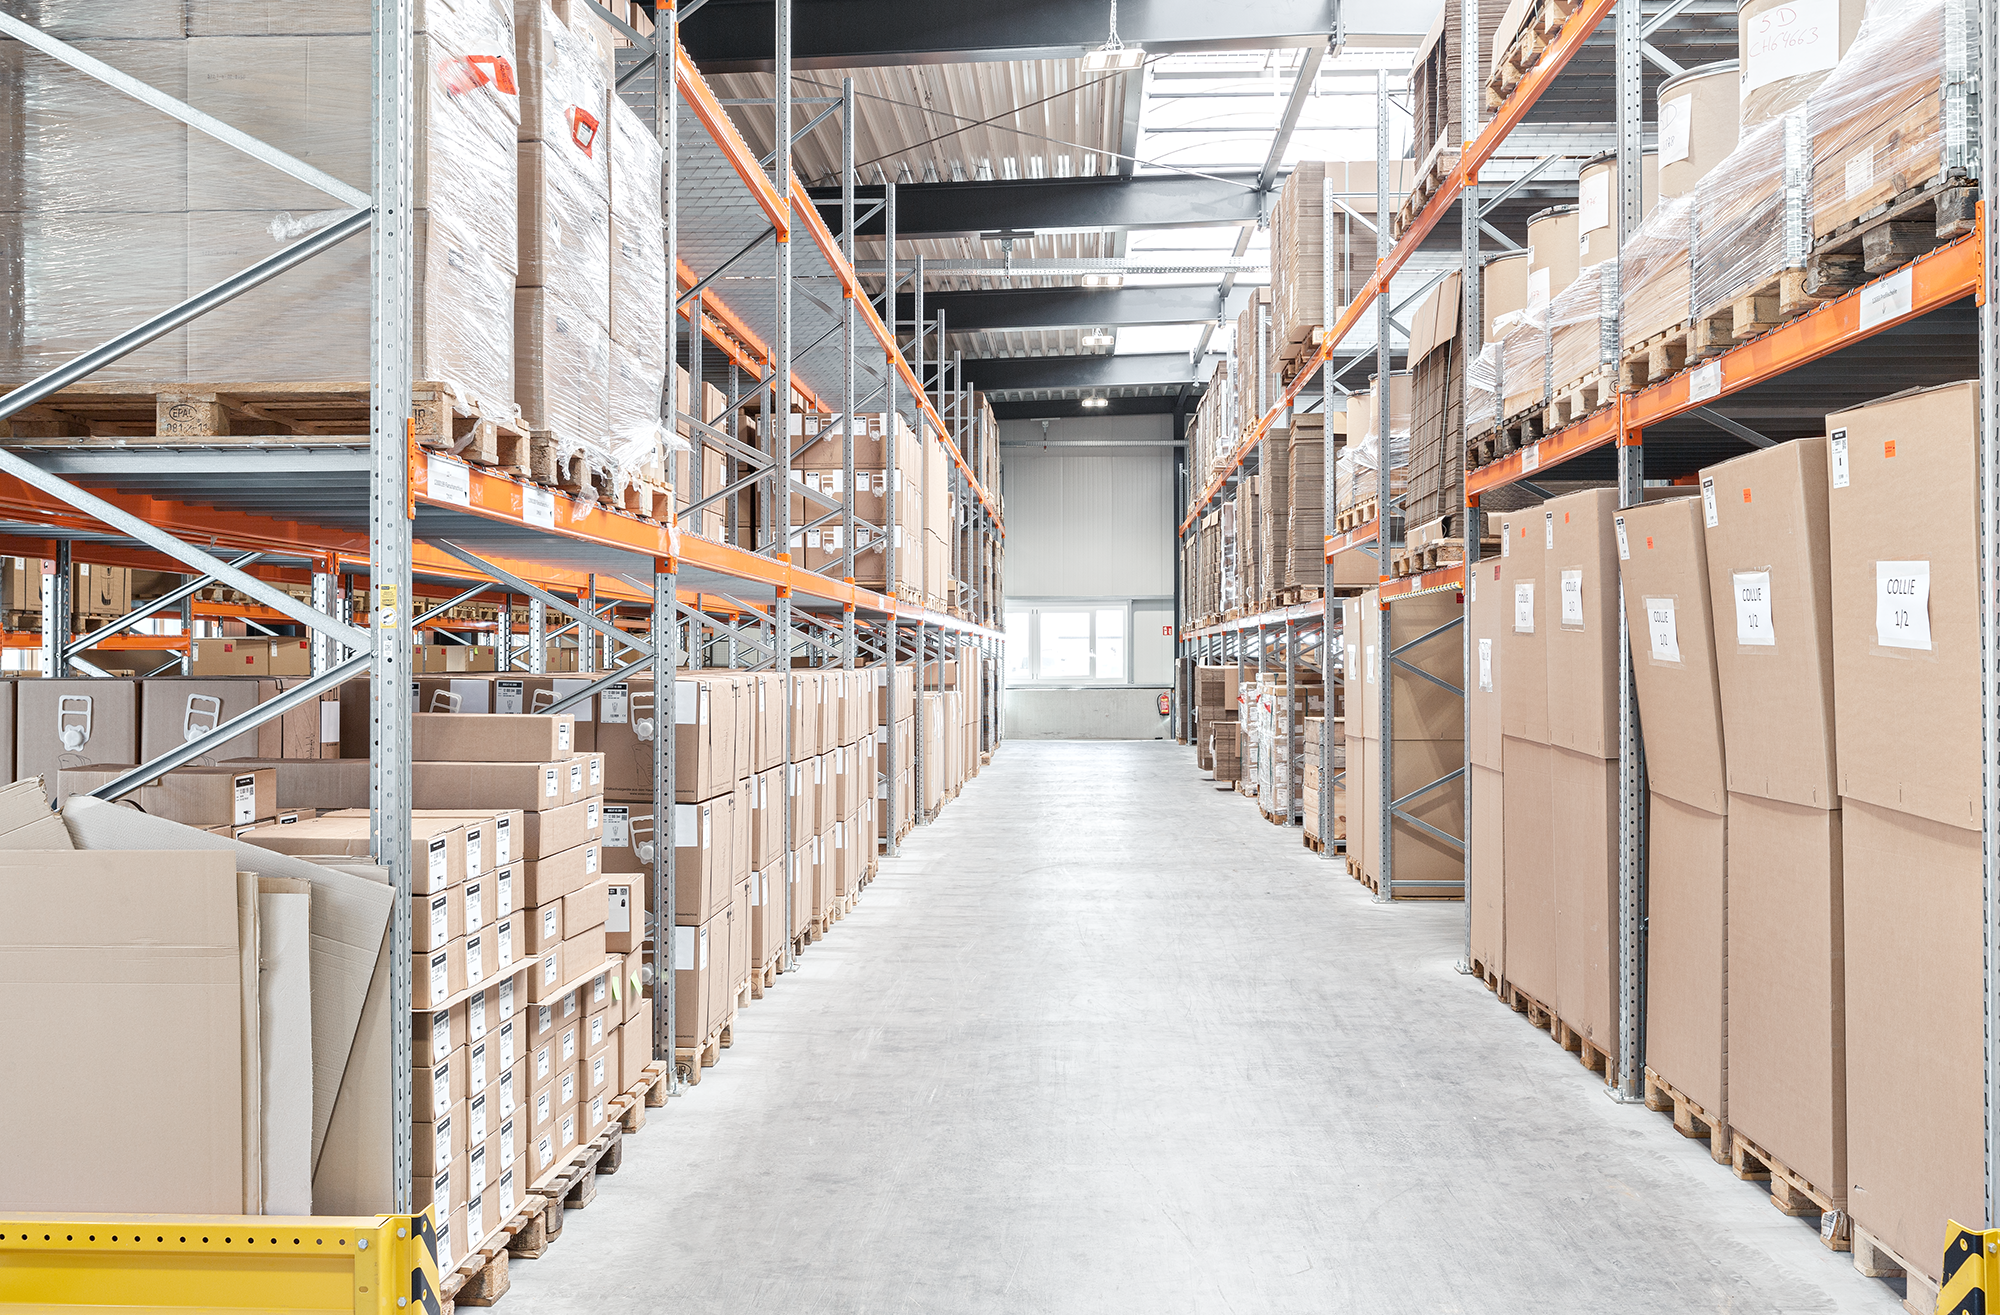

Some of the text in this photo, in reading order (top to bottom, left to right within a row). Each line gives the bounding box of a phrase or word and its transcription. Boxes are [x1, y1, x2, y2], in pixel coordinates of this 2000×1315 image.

[1760, 8, 1797, 33] 5 D
[1742, 587, 1762, 602] COLLIE
[1886, 578, 1916, 595] COLLIE
[1653, 611, 1669, 623] COLLIE
[1748, 613, 1759, 630] 1/2
[1894, 609, 1909, 629] 1/2
[1659, 633, 1668, 647] 1/2
